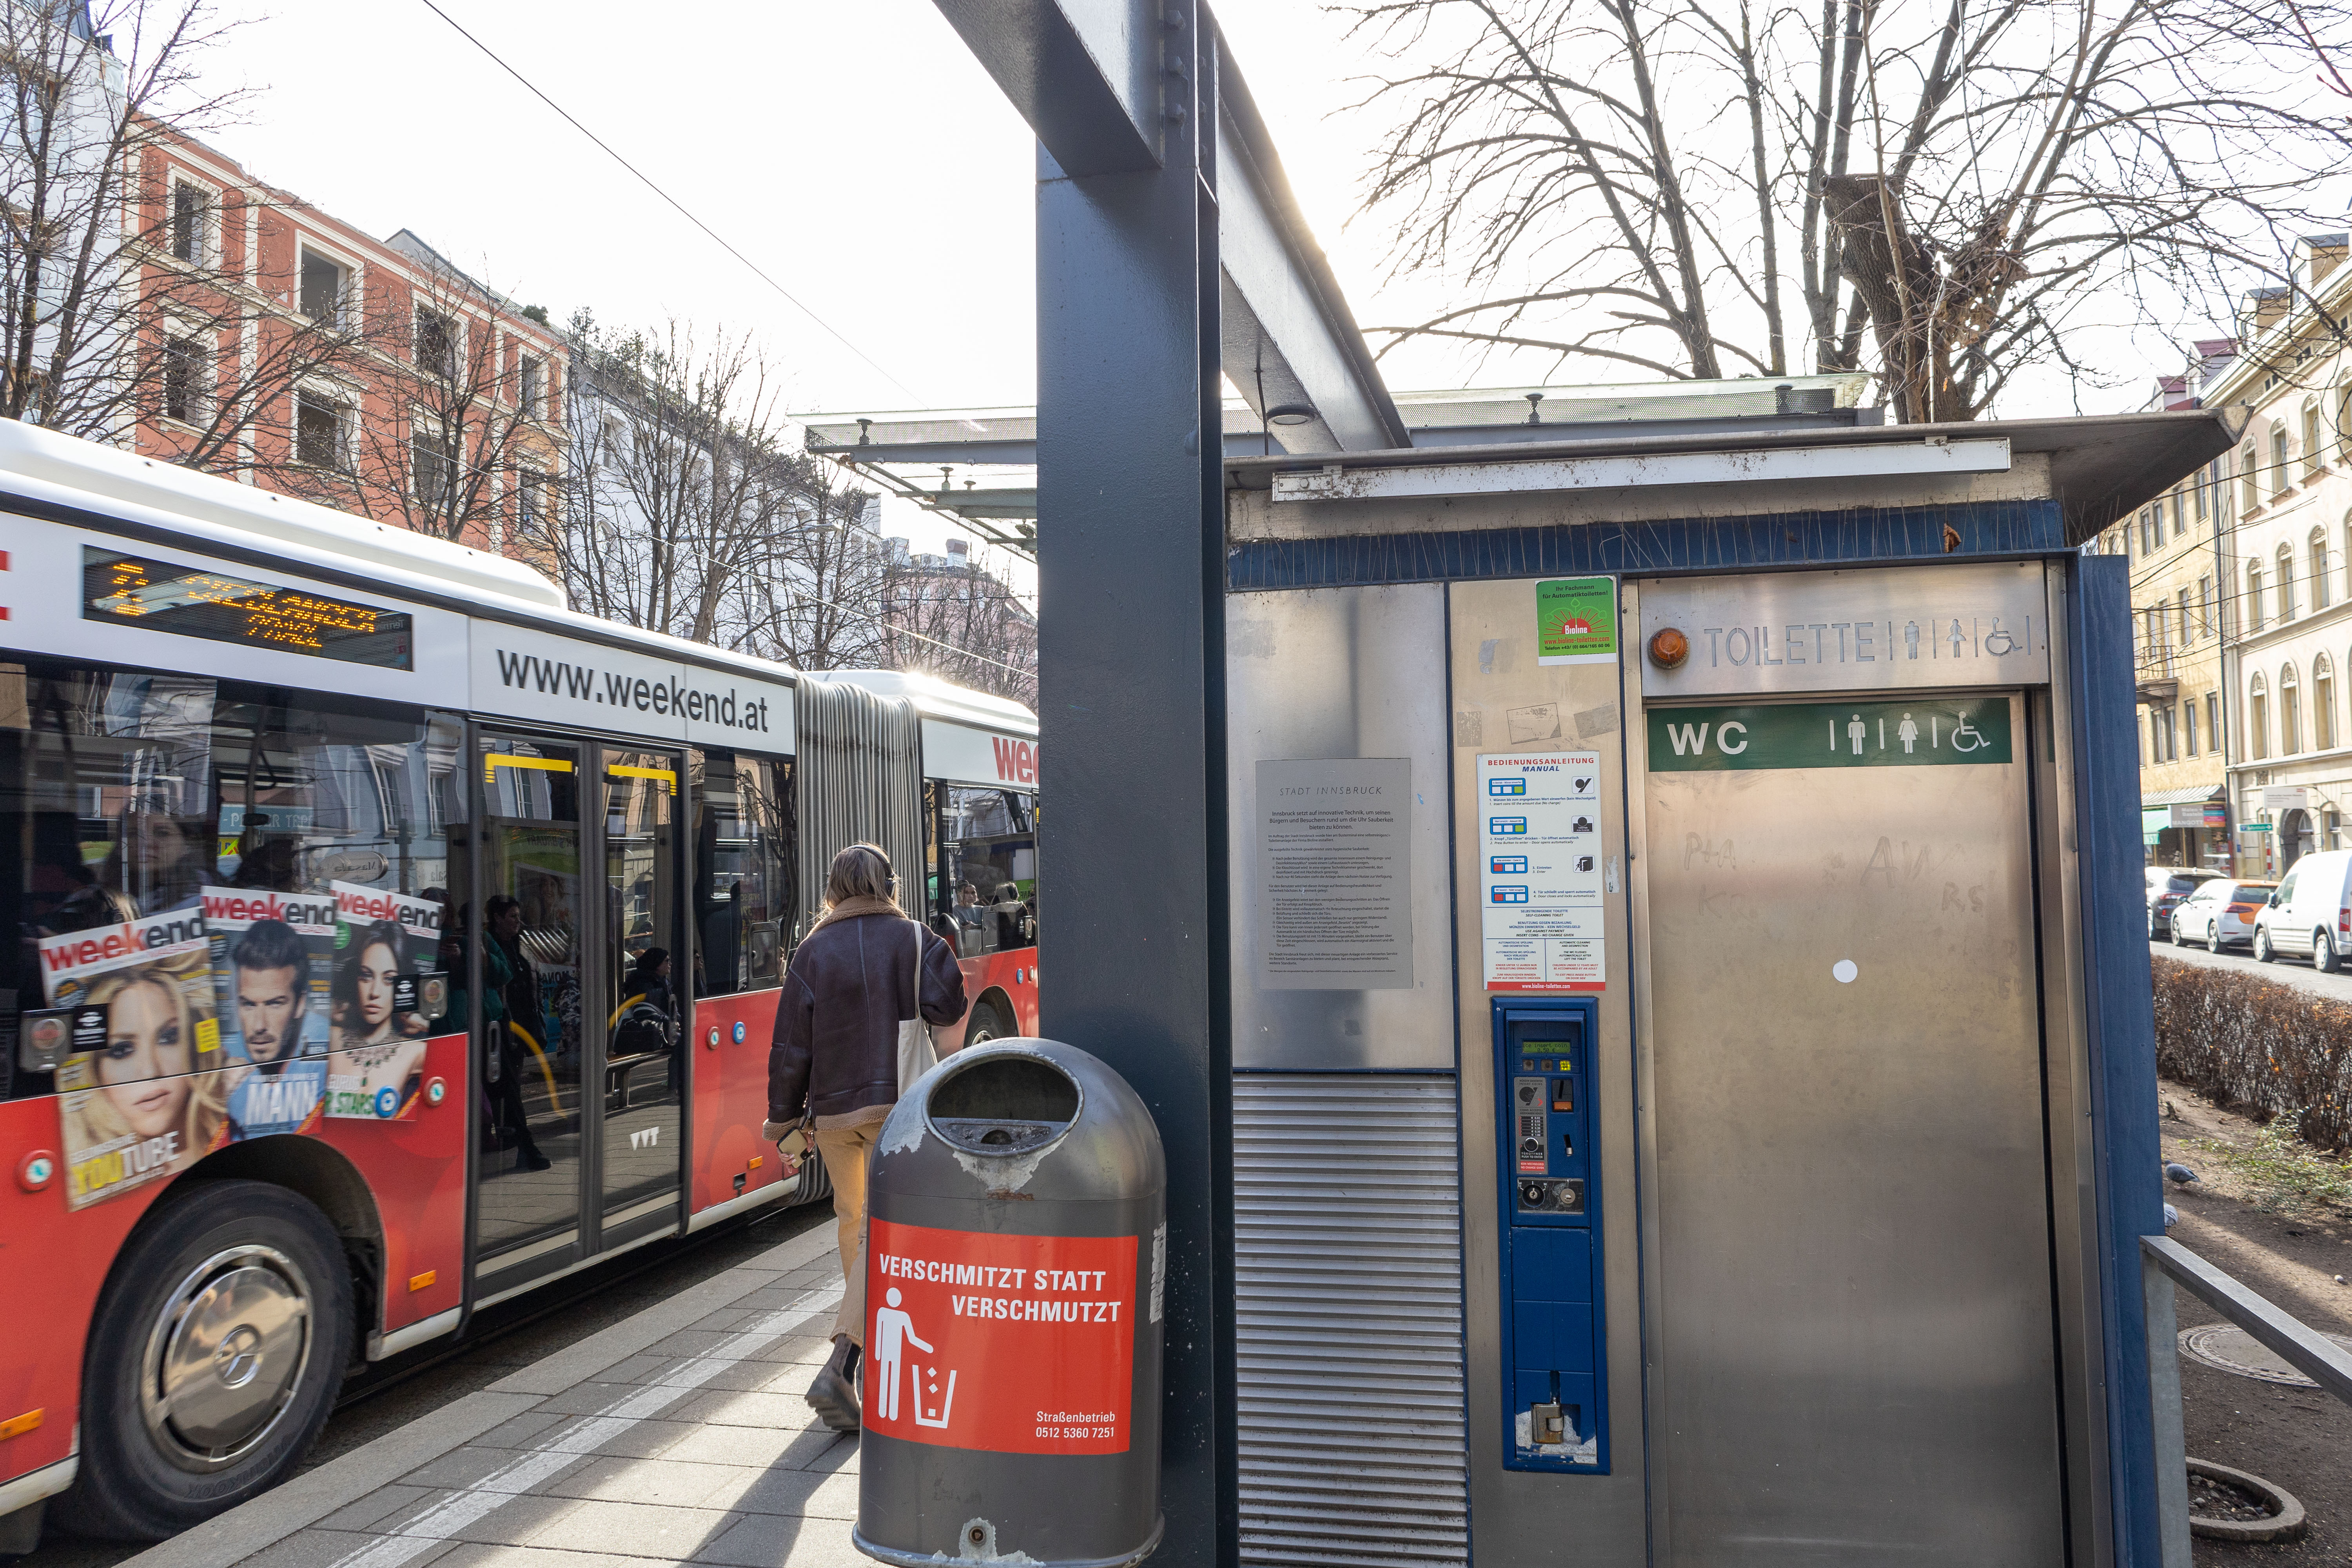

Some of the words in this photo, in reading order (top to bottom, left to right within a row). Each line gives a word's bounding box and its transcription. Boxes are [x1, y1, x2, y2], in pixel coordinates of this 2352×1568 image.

[1552, 590, 1608, 598] Automatiktoiletten!
[1544, 636, 1610, 645] www.bioline-toiletten.com
[1704, 622, 1875, 668] TOILETTE
[497, 649, 769, 733] www.weekend.at
[1667, 721, 1748, 756] WC
[1279, 787, 1310, 796] STADT
[1317, 786, 1382, 795] INNSBRUCK
[203, 893, 338, 925] weekend
[330, 889, 445, 930] weekend
[40, 906, 206, 971] weekend
[246, 1081, 319, 1125] MANN
[879, 1253, 1026, 1289] VERSCHMITZT
[1034, 1270, 1106, 1292] STATT
[952, 1294, 1122, 1323] VERSCHMUTZT
[1036, 1410, 1116, 1423] Straßenbetrieb
[1036, 1426, 1060, 1438] 0512
[1063, 1426, 1089, 1438] 5360
[1092, 1426, 1115, 1438] 7251
